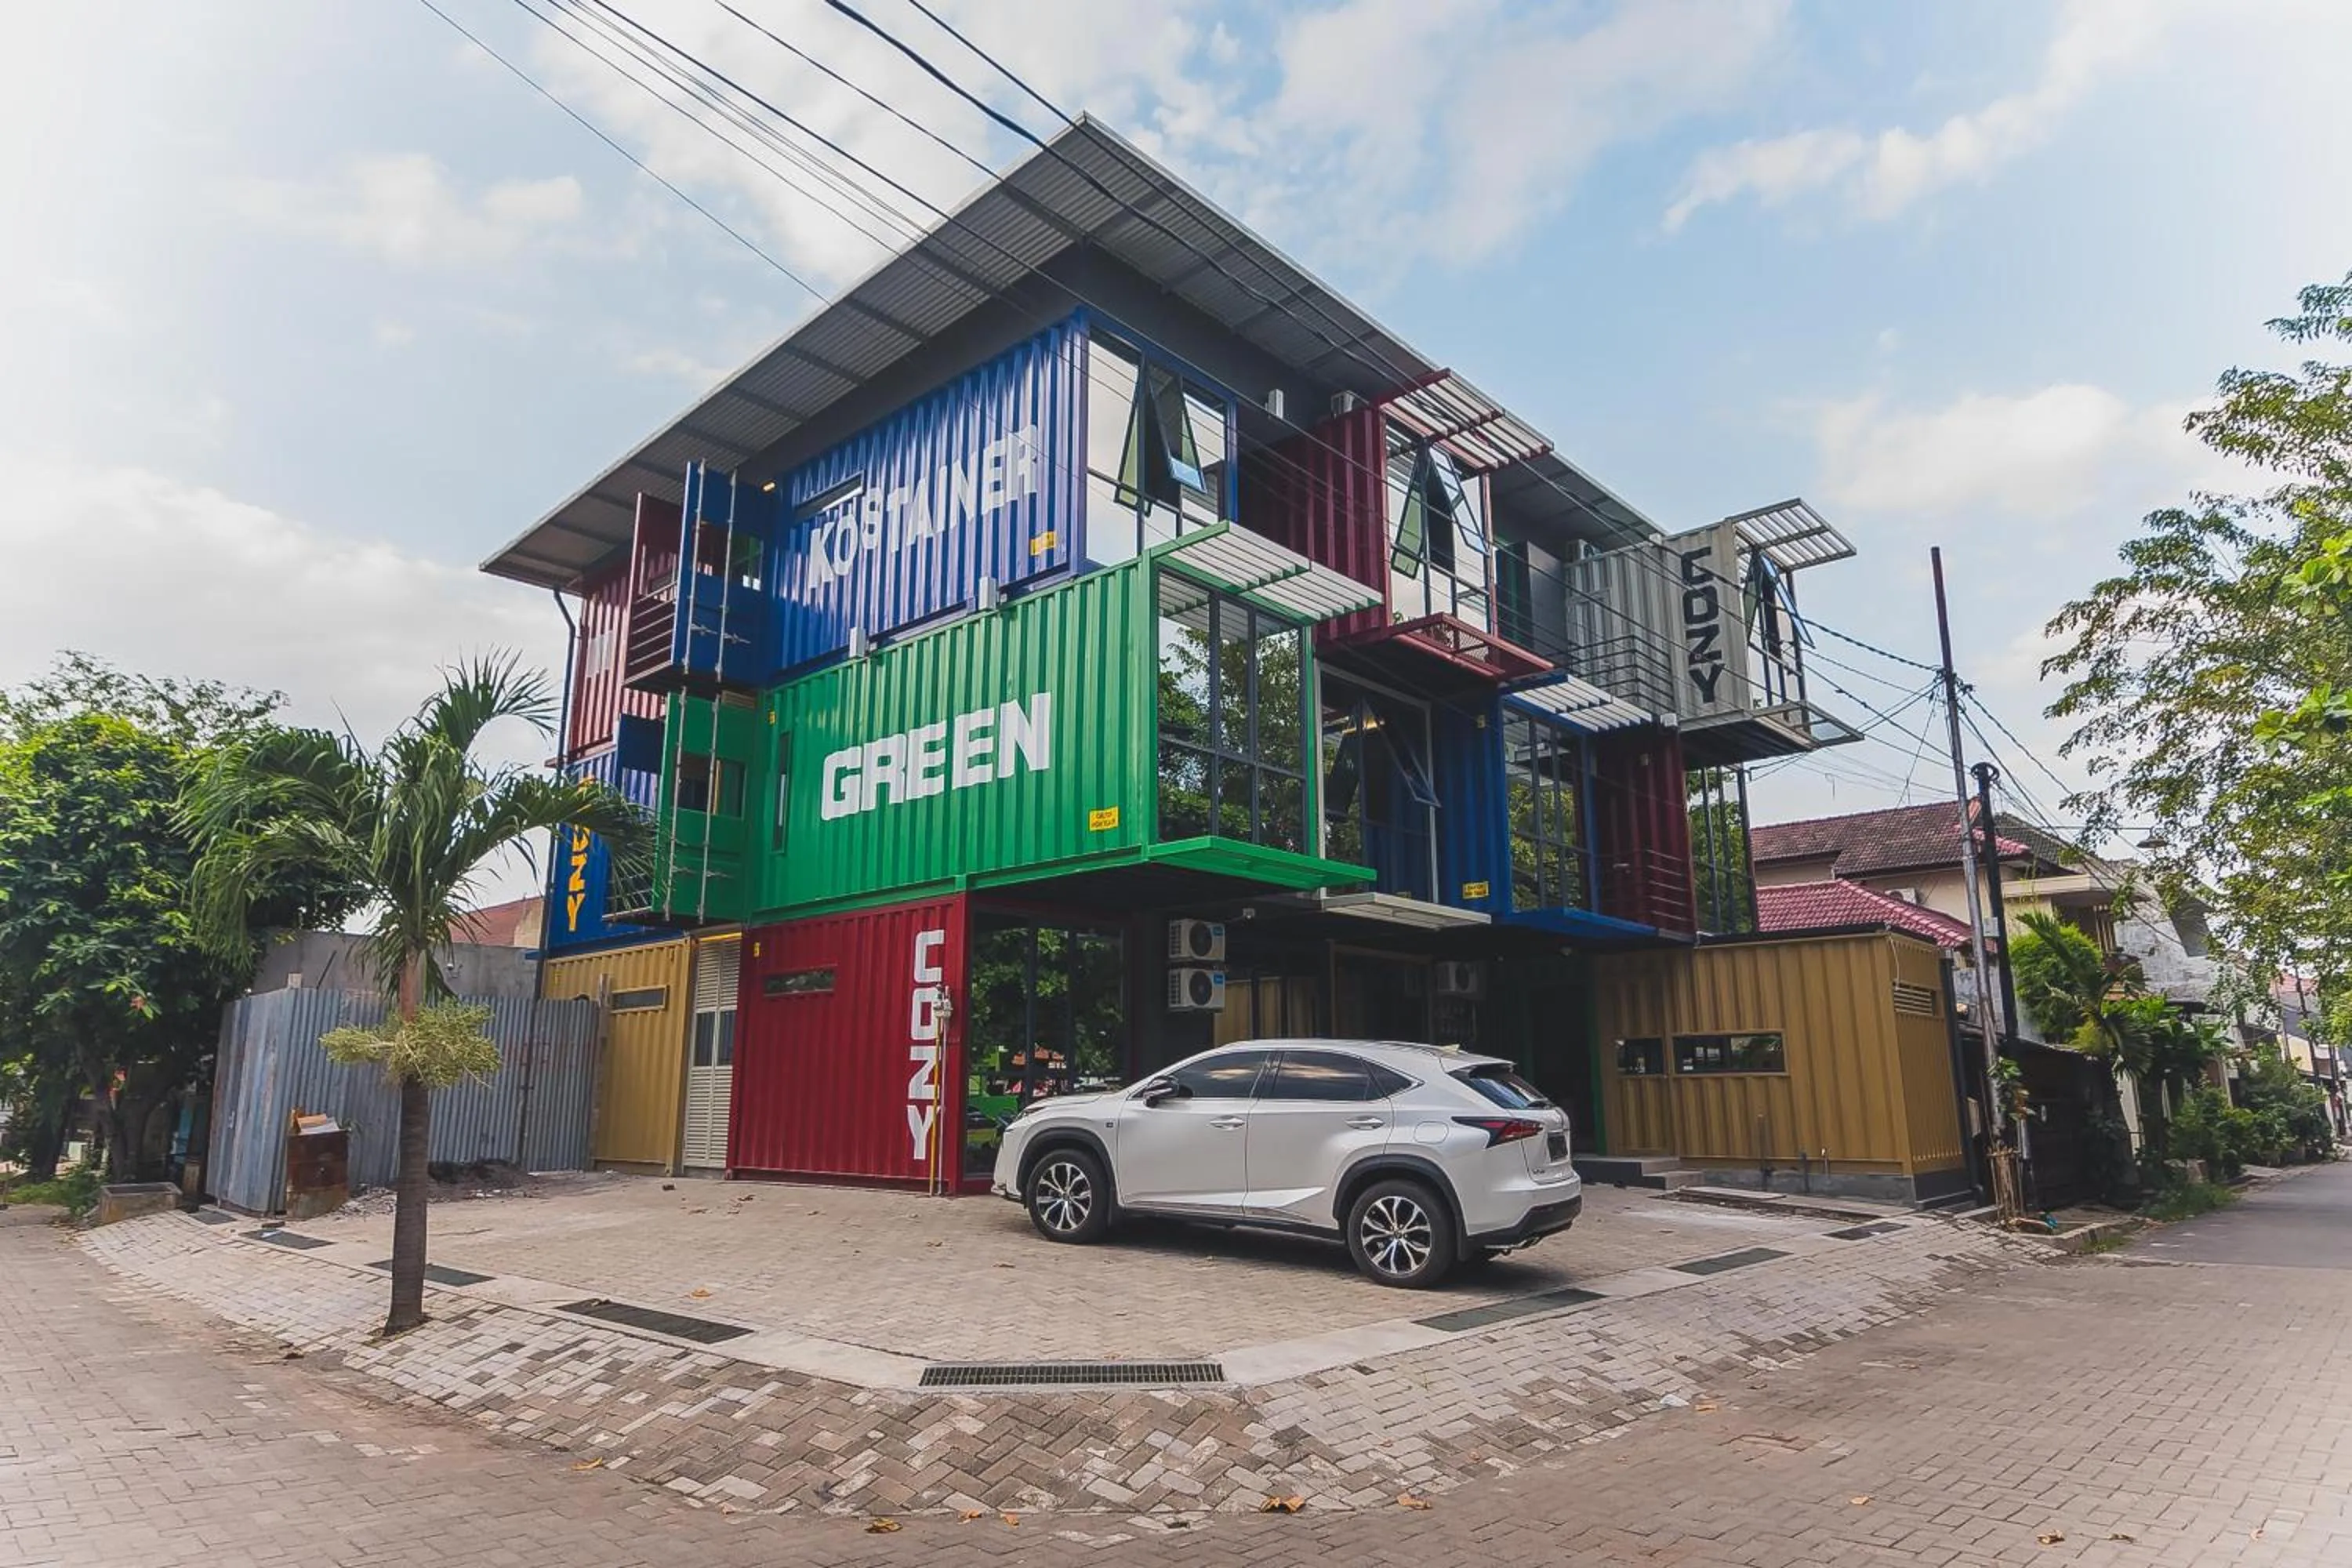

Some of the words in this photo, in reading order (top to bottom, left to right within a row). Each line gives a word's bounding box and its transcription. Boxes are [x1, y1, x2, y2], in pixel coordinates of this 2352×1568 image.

[808, 424, 1037, 590] KOSTAINER
[1681, 546, 1725, 703] COZY
[821, 692, 1051, 820] GREEN
[567, 775, 596, 931] OZY
[907, 929, 945, 1160] COZY
